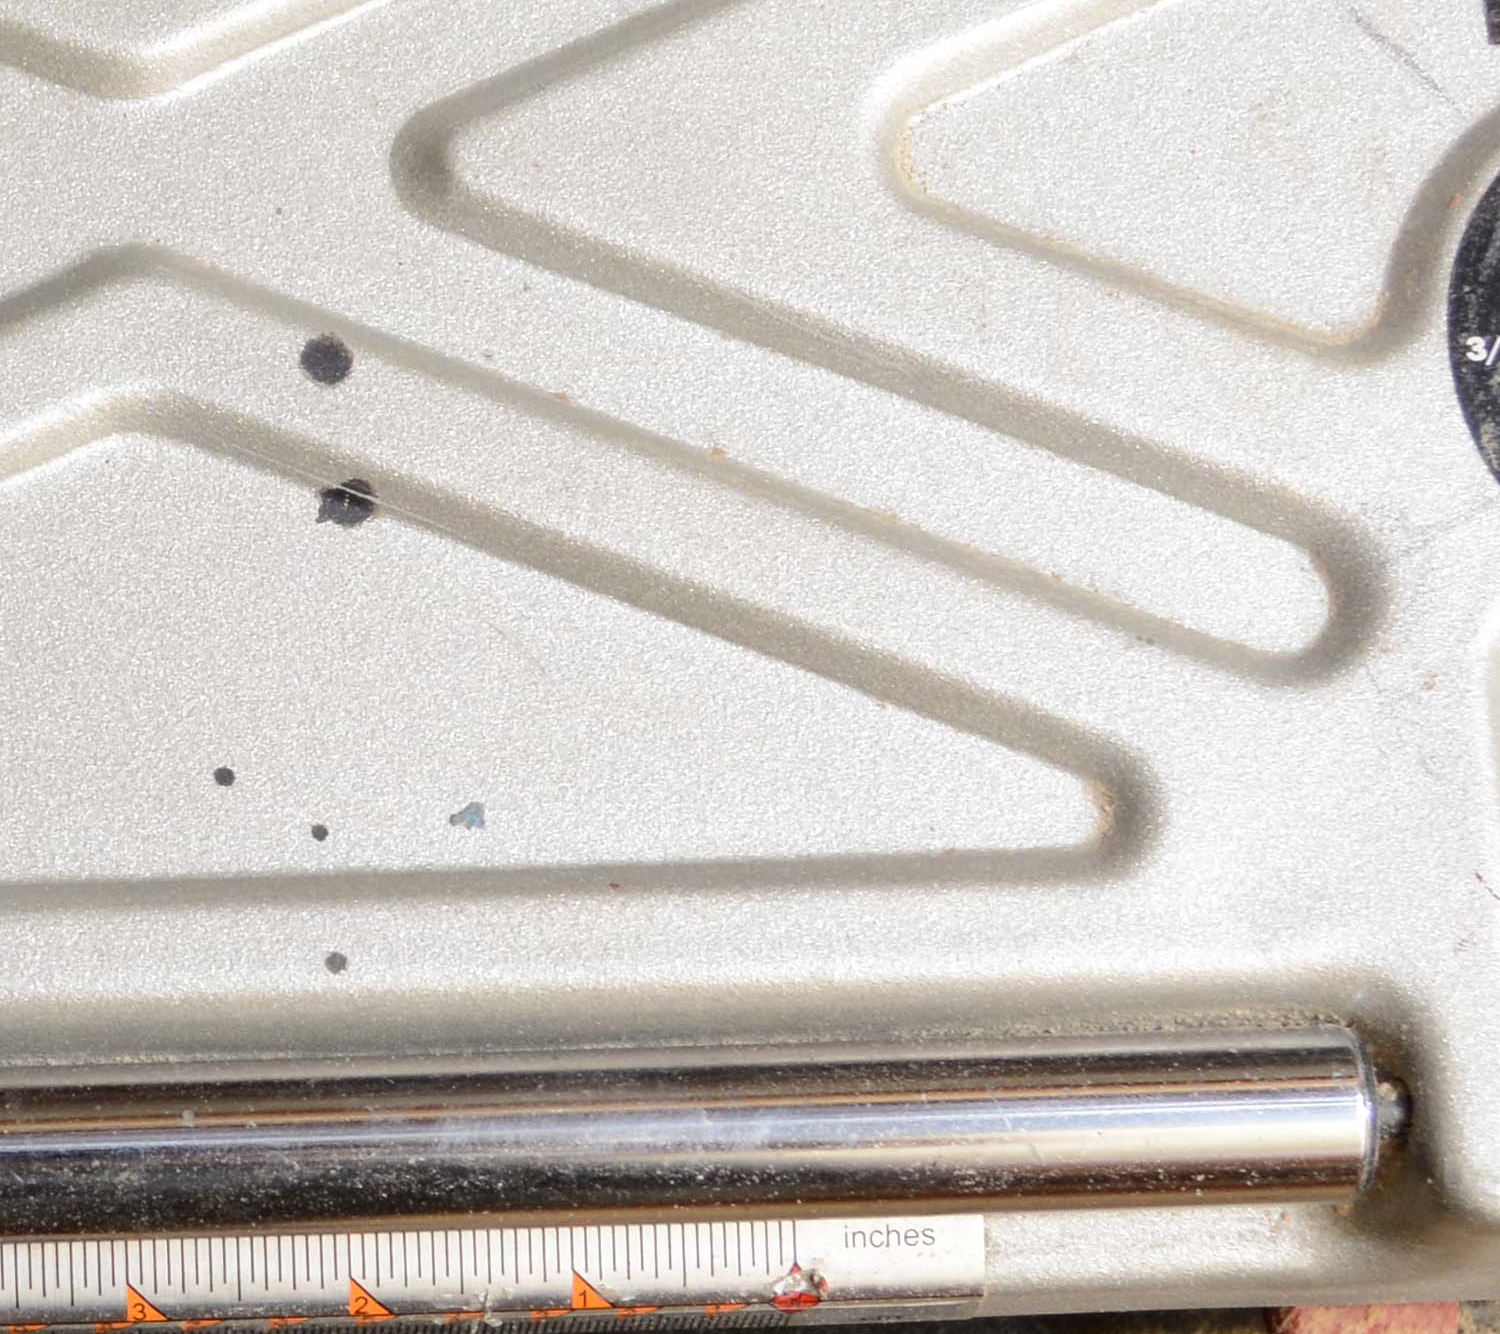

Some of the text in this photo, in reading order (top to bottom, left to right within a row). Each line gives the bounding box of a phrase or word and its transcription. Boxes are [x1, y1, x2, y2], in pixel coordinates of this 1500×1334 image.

[843, 1224, 937, 1250] inches
[132, 1302, 147, 1321] 3
[354, 1296, 369, 1315] 2
[579, 1291, 588, 1309] 1
